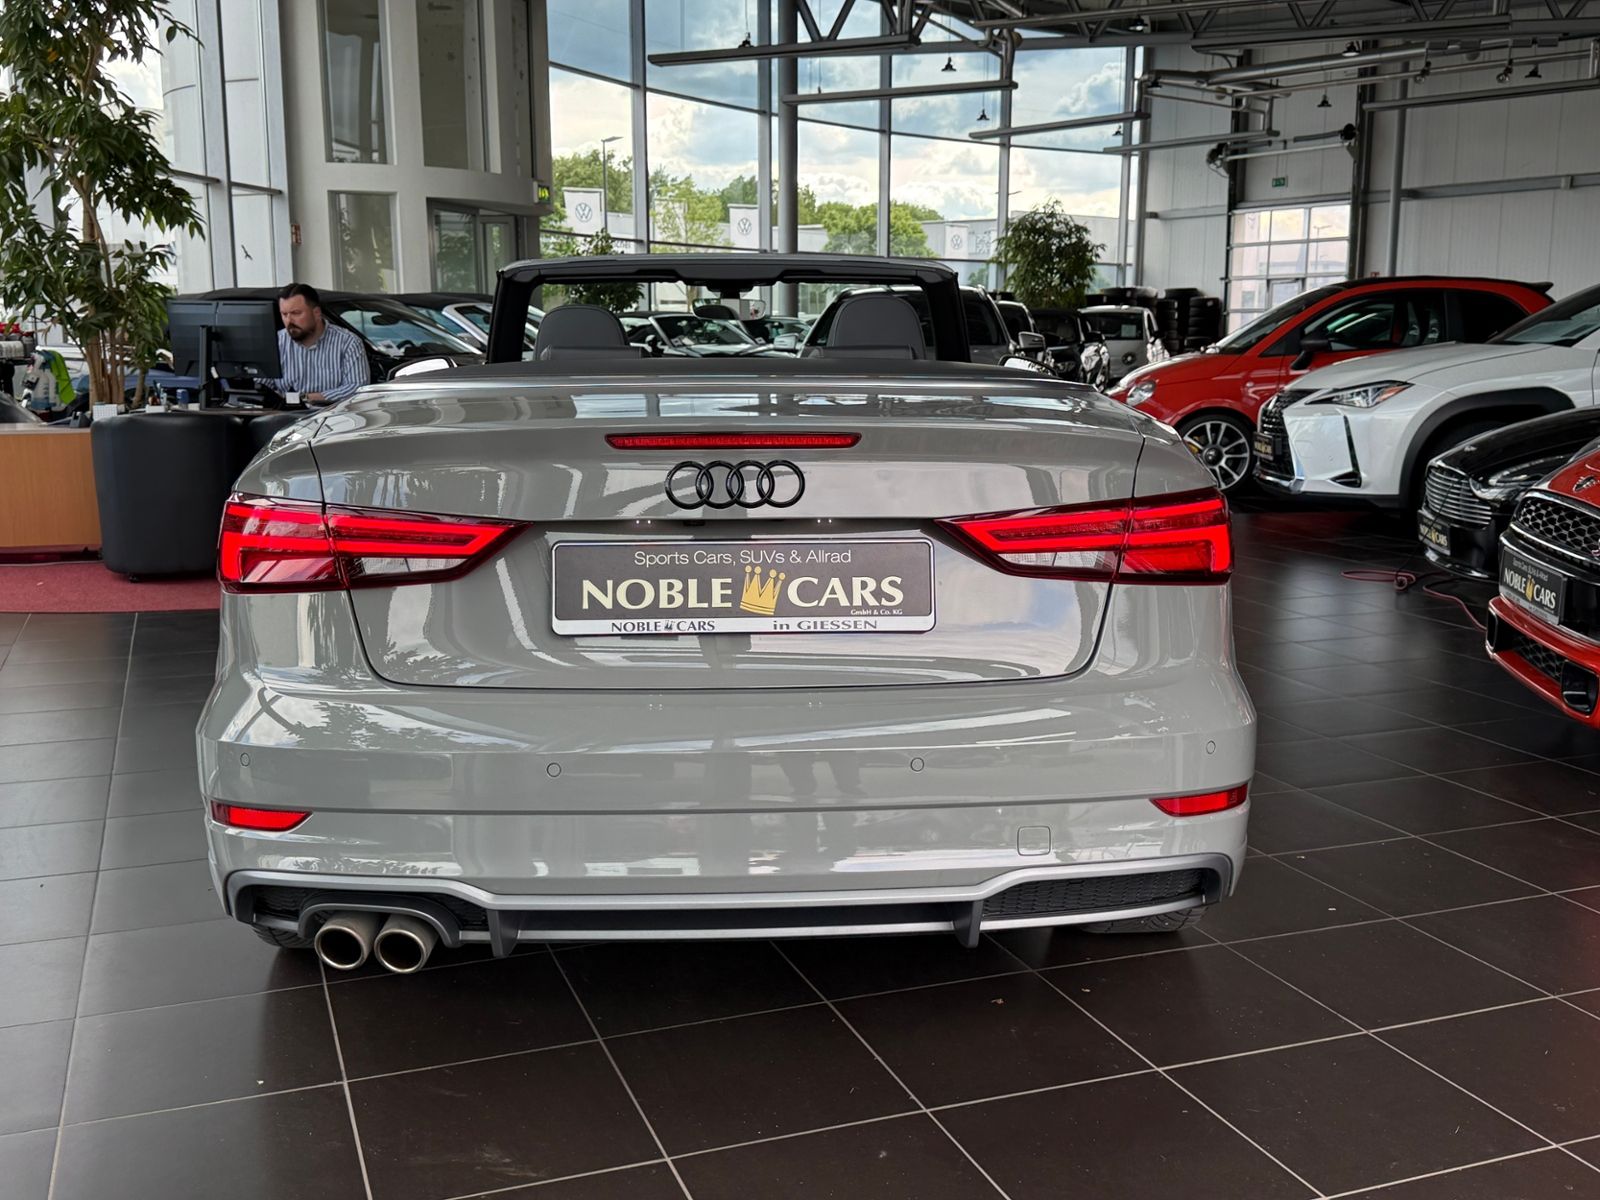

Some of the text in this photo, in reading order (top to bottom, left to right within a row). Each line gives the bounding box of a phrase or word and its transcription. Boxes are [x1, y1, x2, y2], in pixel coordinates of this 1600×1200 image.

[634, 549, 852, 568] Sports Cars, SUVs & Allrad
[582, 575, 904, 610] NOBLE CARS
[1503, 567, 1527, 594] NOBLE
[1533, 584, 1557, 609] CARS
[611, 620, 715, 633] NOBLE CARS
[773, 620, 878, 631] in GIESSEN
